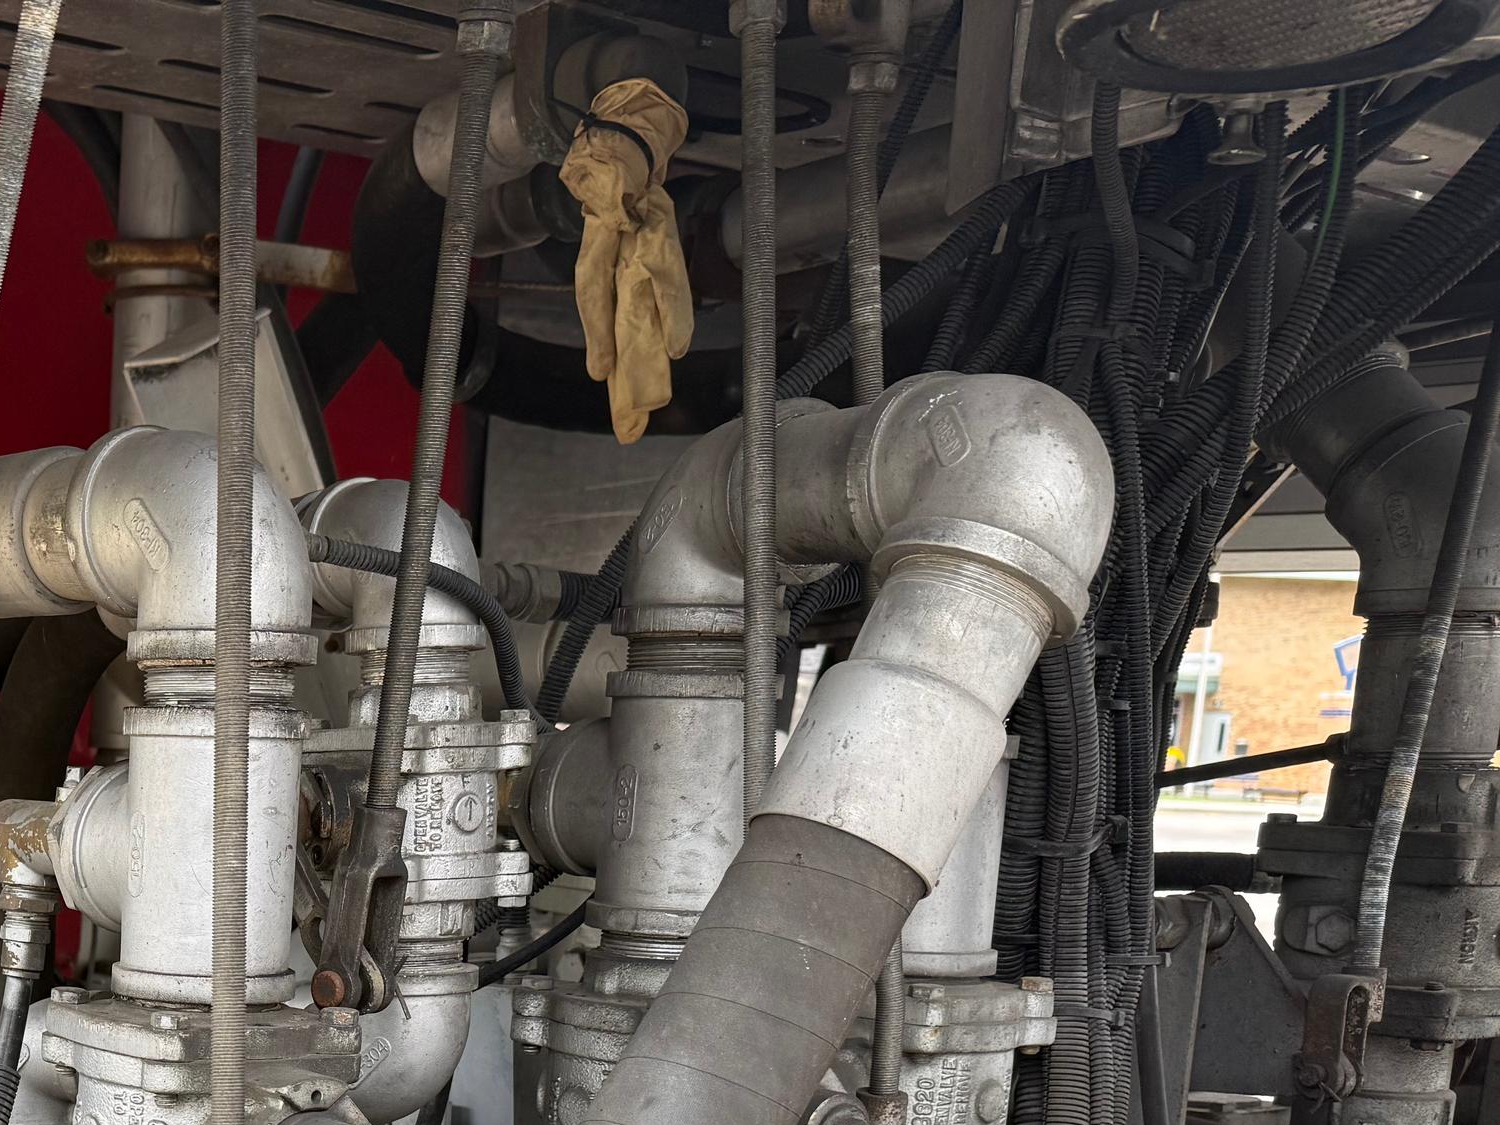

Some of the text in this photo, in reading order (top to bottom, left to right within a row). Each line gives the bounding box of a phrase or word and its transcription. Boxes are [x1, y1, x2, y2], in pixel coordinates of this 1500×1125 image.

[415, 778, 429, 819] VALVE
[937, 1058, 958, 1106] VALVE
[112, 1091, 128, 1116] TO
